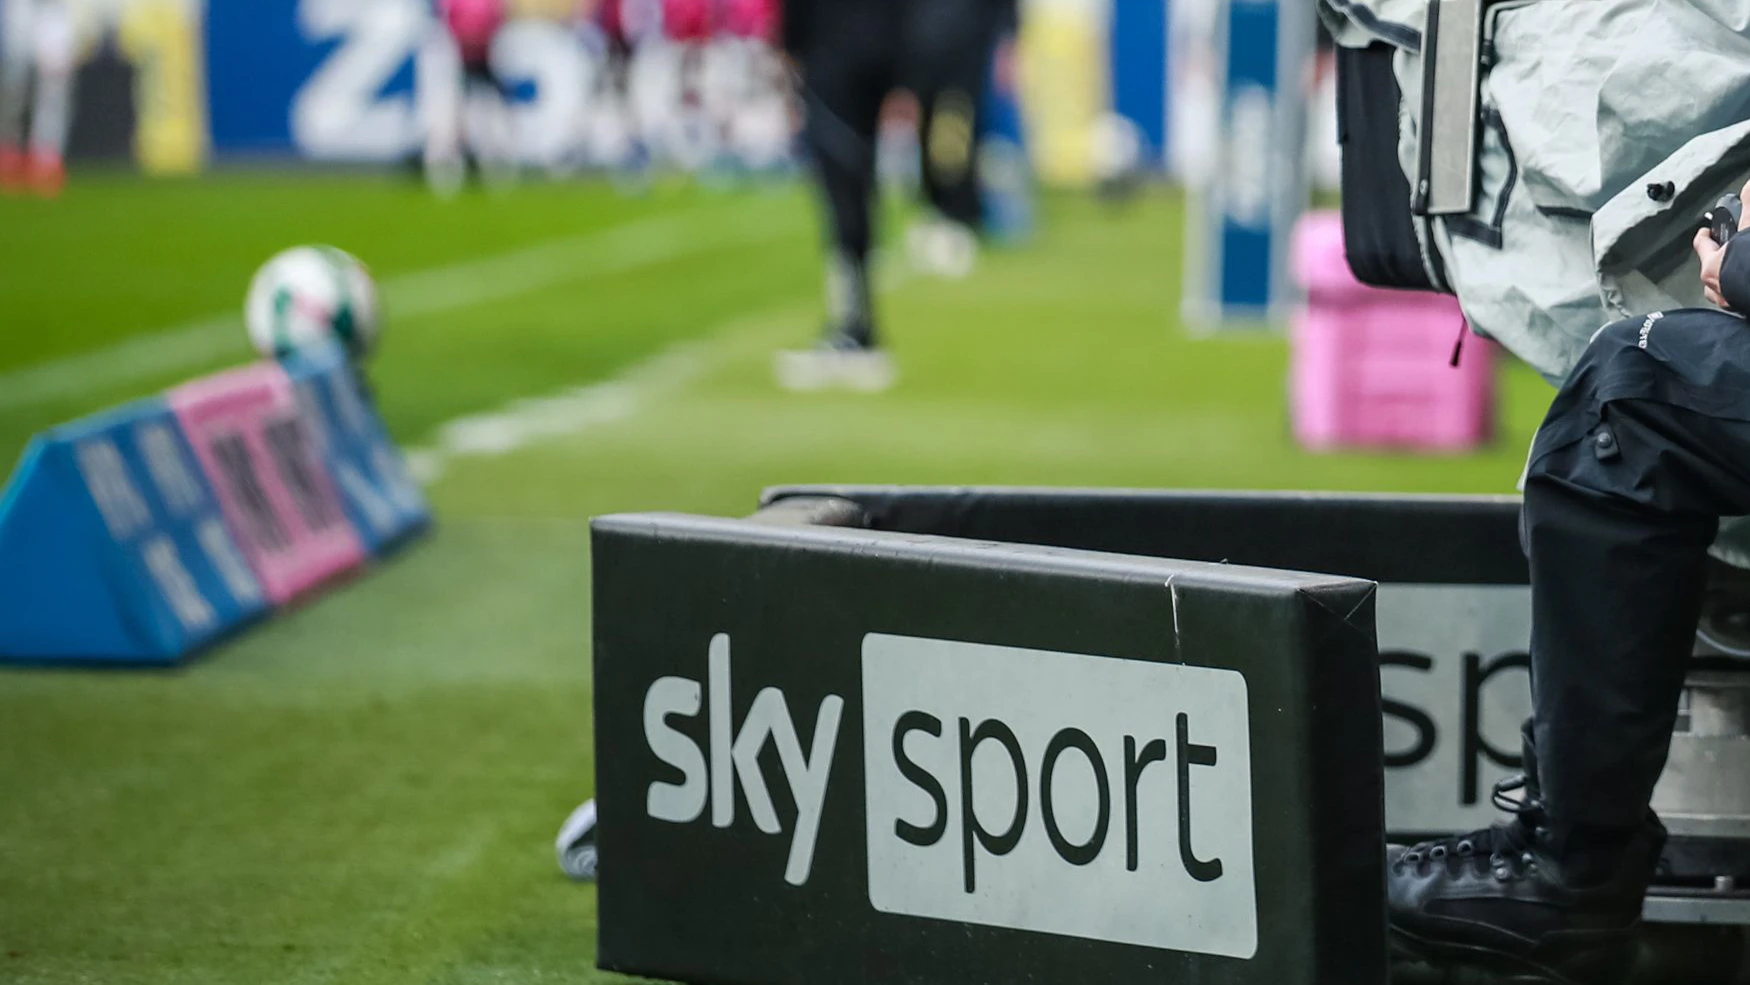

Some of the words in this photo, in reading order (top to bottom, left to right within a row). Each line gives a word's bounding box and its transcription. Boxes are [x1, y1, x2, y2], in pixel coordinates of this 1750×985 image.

[643, 633, 844, 885] sky
[892, 710, 1224, 894] sport
[1378, 649, 1532, 806] sp
